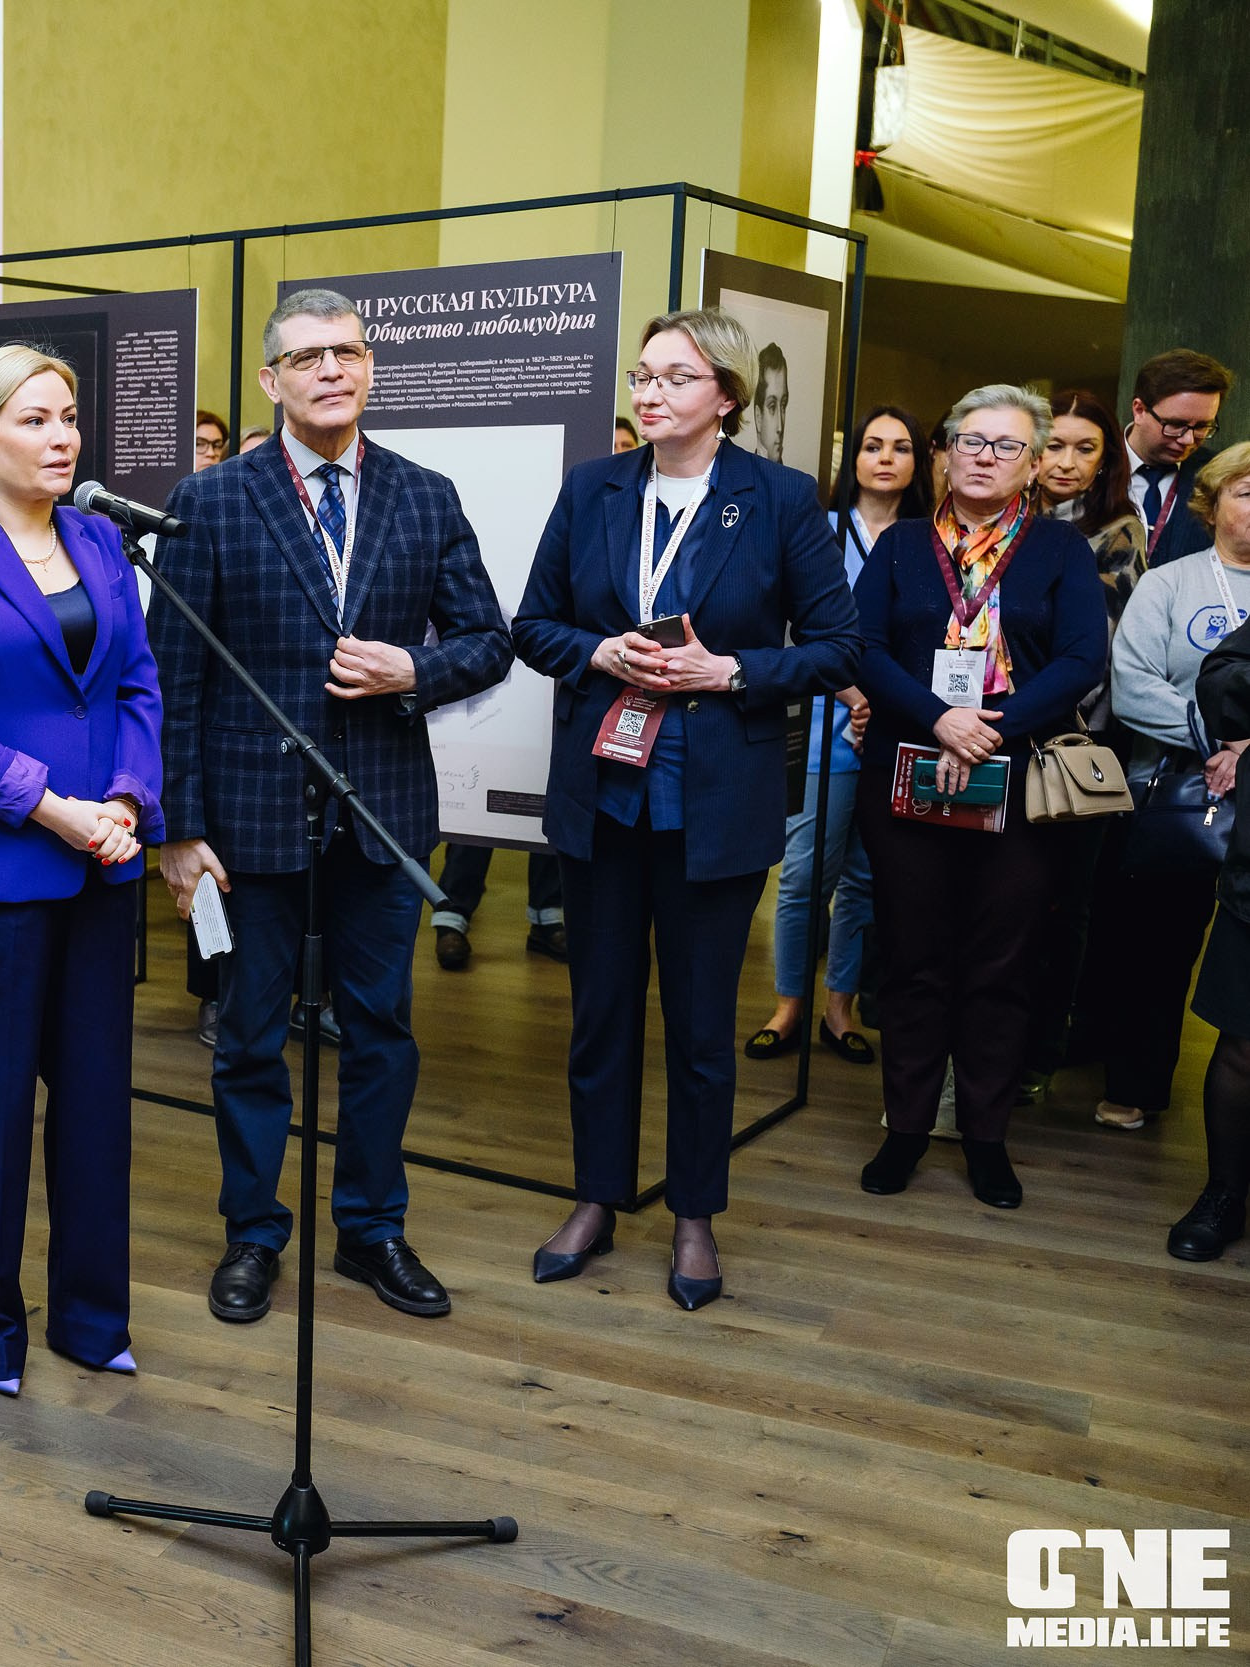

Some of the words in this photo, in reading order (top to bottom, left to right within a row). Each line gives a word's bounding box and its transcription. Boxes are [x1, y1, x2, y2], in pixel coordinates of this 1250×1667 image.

[357, 299, 371, 318] И
[376, 291, 475, 317] РУССКАЯ
[480, 282, 598, 310] КУЛЬТУРА
[365, 318, 463, 345] Общество
[466, 310, 597, 338] любомудрия
[495, 382, 522, 390] Общество
